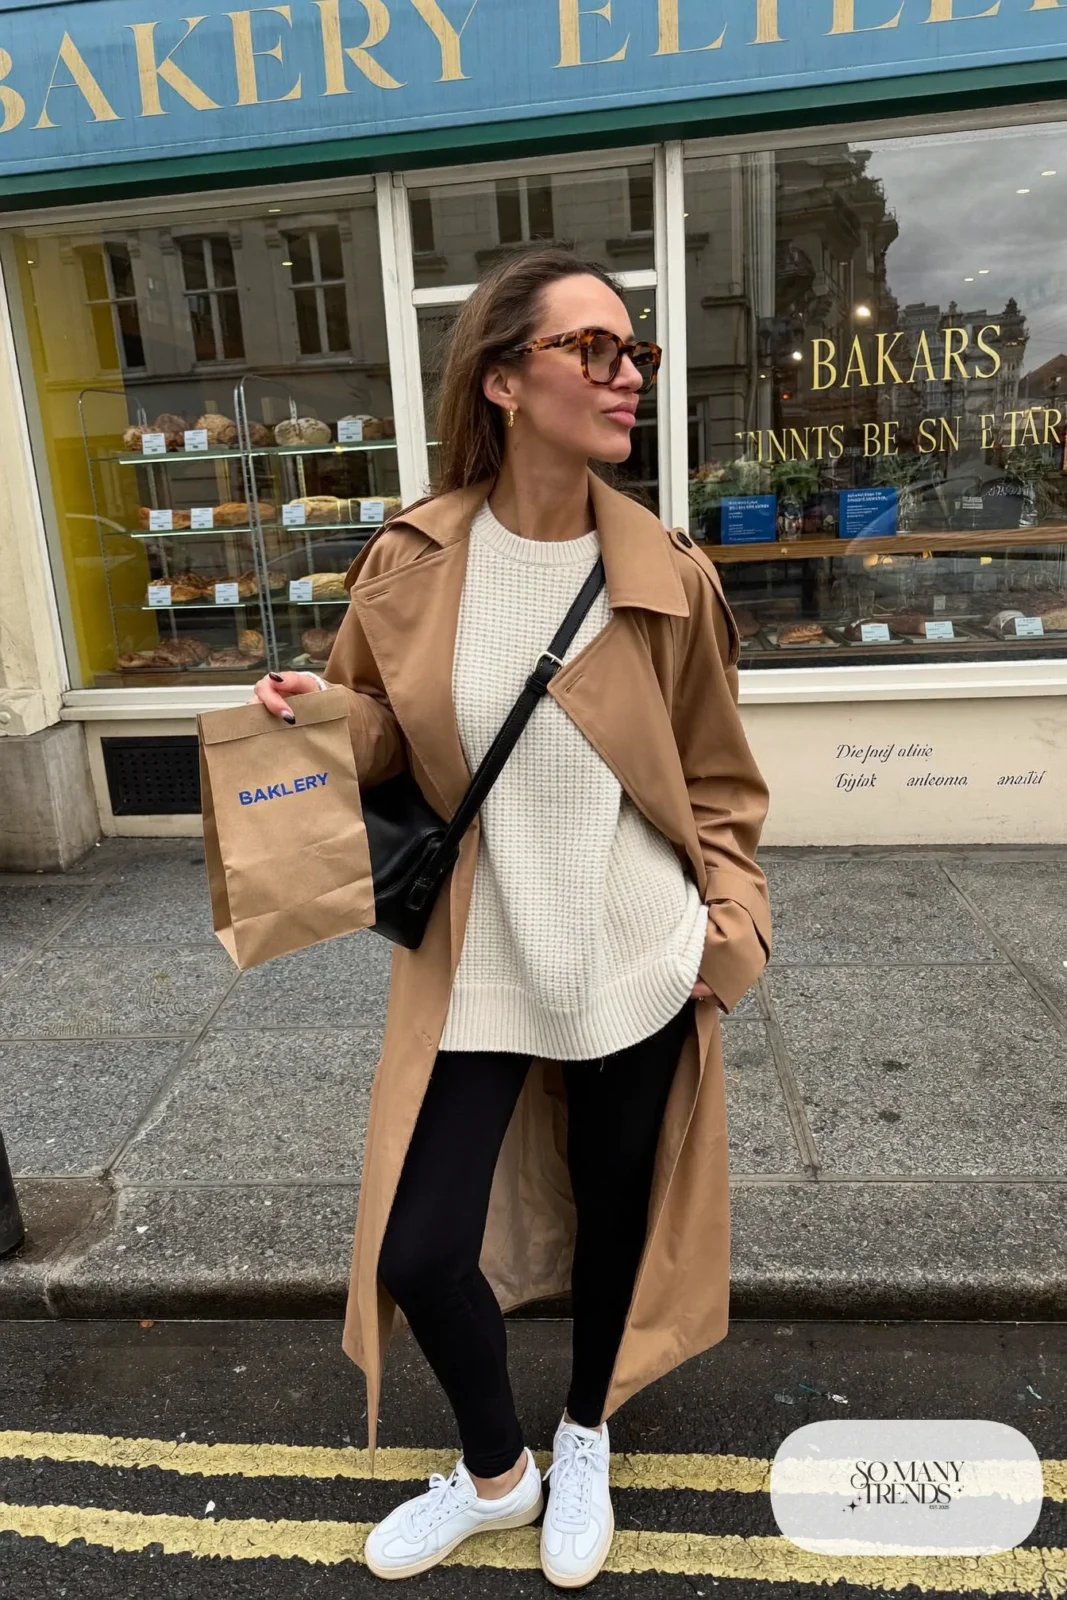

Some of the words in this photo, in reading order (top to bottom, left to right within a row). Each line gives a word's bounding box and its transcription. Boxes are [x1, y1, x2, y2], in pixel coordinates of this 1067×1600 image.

[810, 324, 1001, 391] BAKARS
[862, 421, 900, 458] BE
[918, 416, 963, 453] SN
[238, 772, 329, 805] BAKLERY
